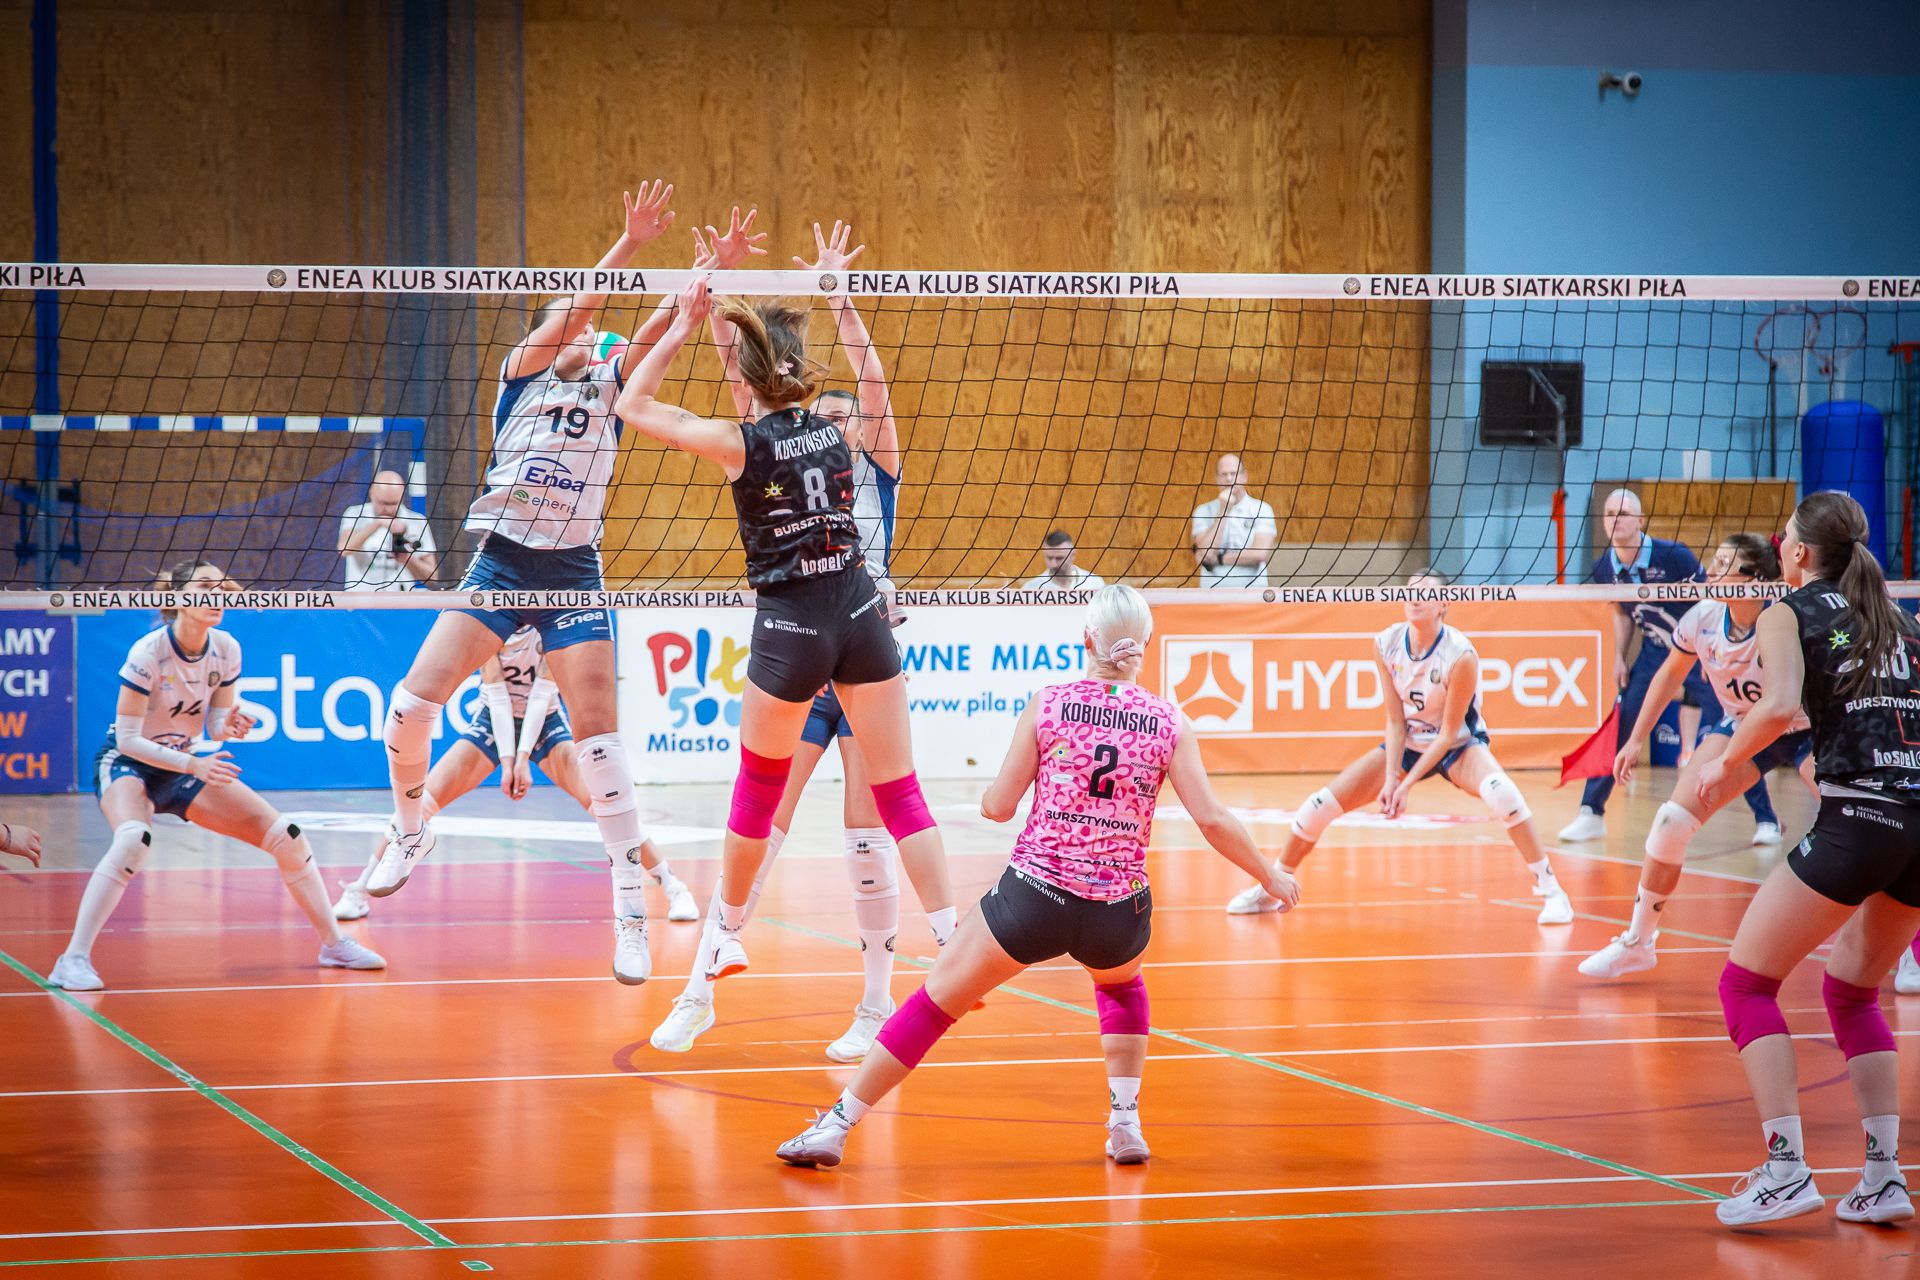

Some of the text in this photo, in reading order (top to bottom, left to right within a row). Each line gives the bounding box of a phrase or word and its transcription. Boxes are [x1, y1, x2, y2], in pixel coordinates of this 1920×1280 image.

[30, 266, 86, 287] PIŁA
[298, 269, 647, 292] ENEA KLUB SIATKARSKI PIŁA
[848, 273, 1179, 295] ENEA KLUB SIATKARSKI PIŁA
[1370, 277, 1686, 297] ENEA KLUB SIATKARSKI PIŁA
[545, 406, 590, 439] 19
[774, 425, 840, 461] KUCZYŃSKA
[524, 465, 586, 492] Enea
[803, 467, 829, 510] 8
[531, 496, 577, 515] eneris
[72, 592, 335, 608] ENEA KLUB SIATKARSKI PIŁA
[491, 590, 744, 608] ENEA KLUB SIATKARSKI PIŁA
[895, 590, 941, 606] ENEA
[947, 590, 991, 606] KLUB
[1282, 586, 1517, 602] ENEA KLUB SIATKARSKI PIŁA
[1657, 585, 1700, 599] ENEA
[1705, 585, 1746, 599] KLUB
[557, 611, 604, 630] Enea
[775, 623, 818, 636] HUMANITAS
[0, 627, 56, 656] MY
[991, 644, 1085, 671] MIAST
[503, 665, 536, 686] 21
[1266, 657, 1589, 710] HYDPEX
[1409, 691, 1425, 711] 5
[1725, 678, 1762, 704] 16
[169, 699, 203, 719] 14
[1061, 702, 1159, 736] KOBUSIŃSKA
[647, 733, 731, 752] Miasto
[1088, 744, 1119, 800] 2
[1046, 810, 1140, 833] BURSZTYNOWY
[1856, 811, 1904, 830] HUMANITAS
[1023, 875, 1066, 906] HUMANITAS
